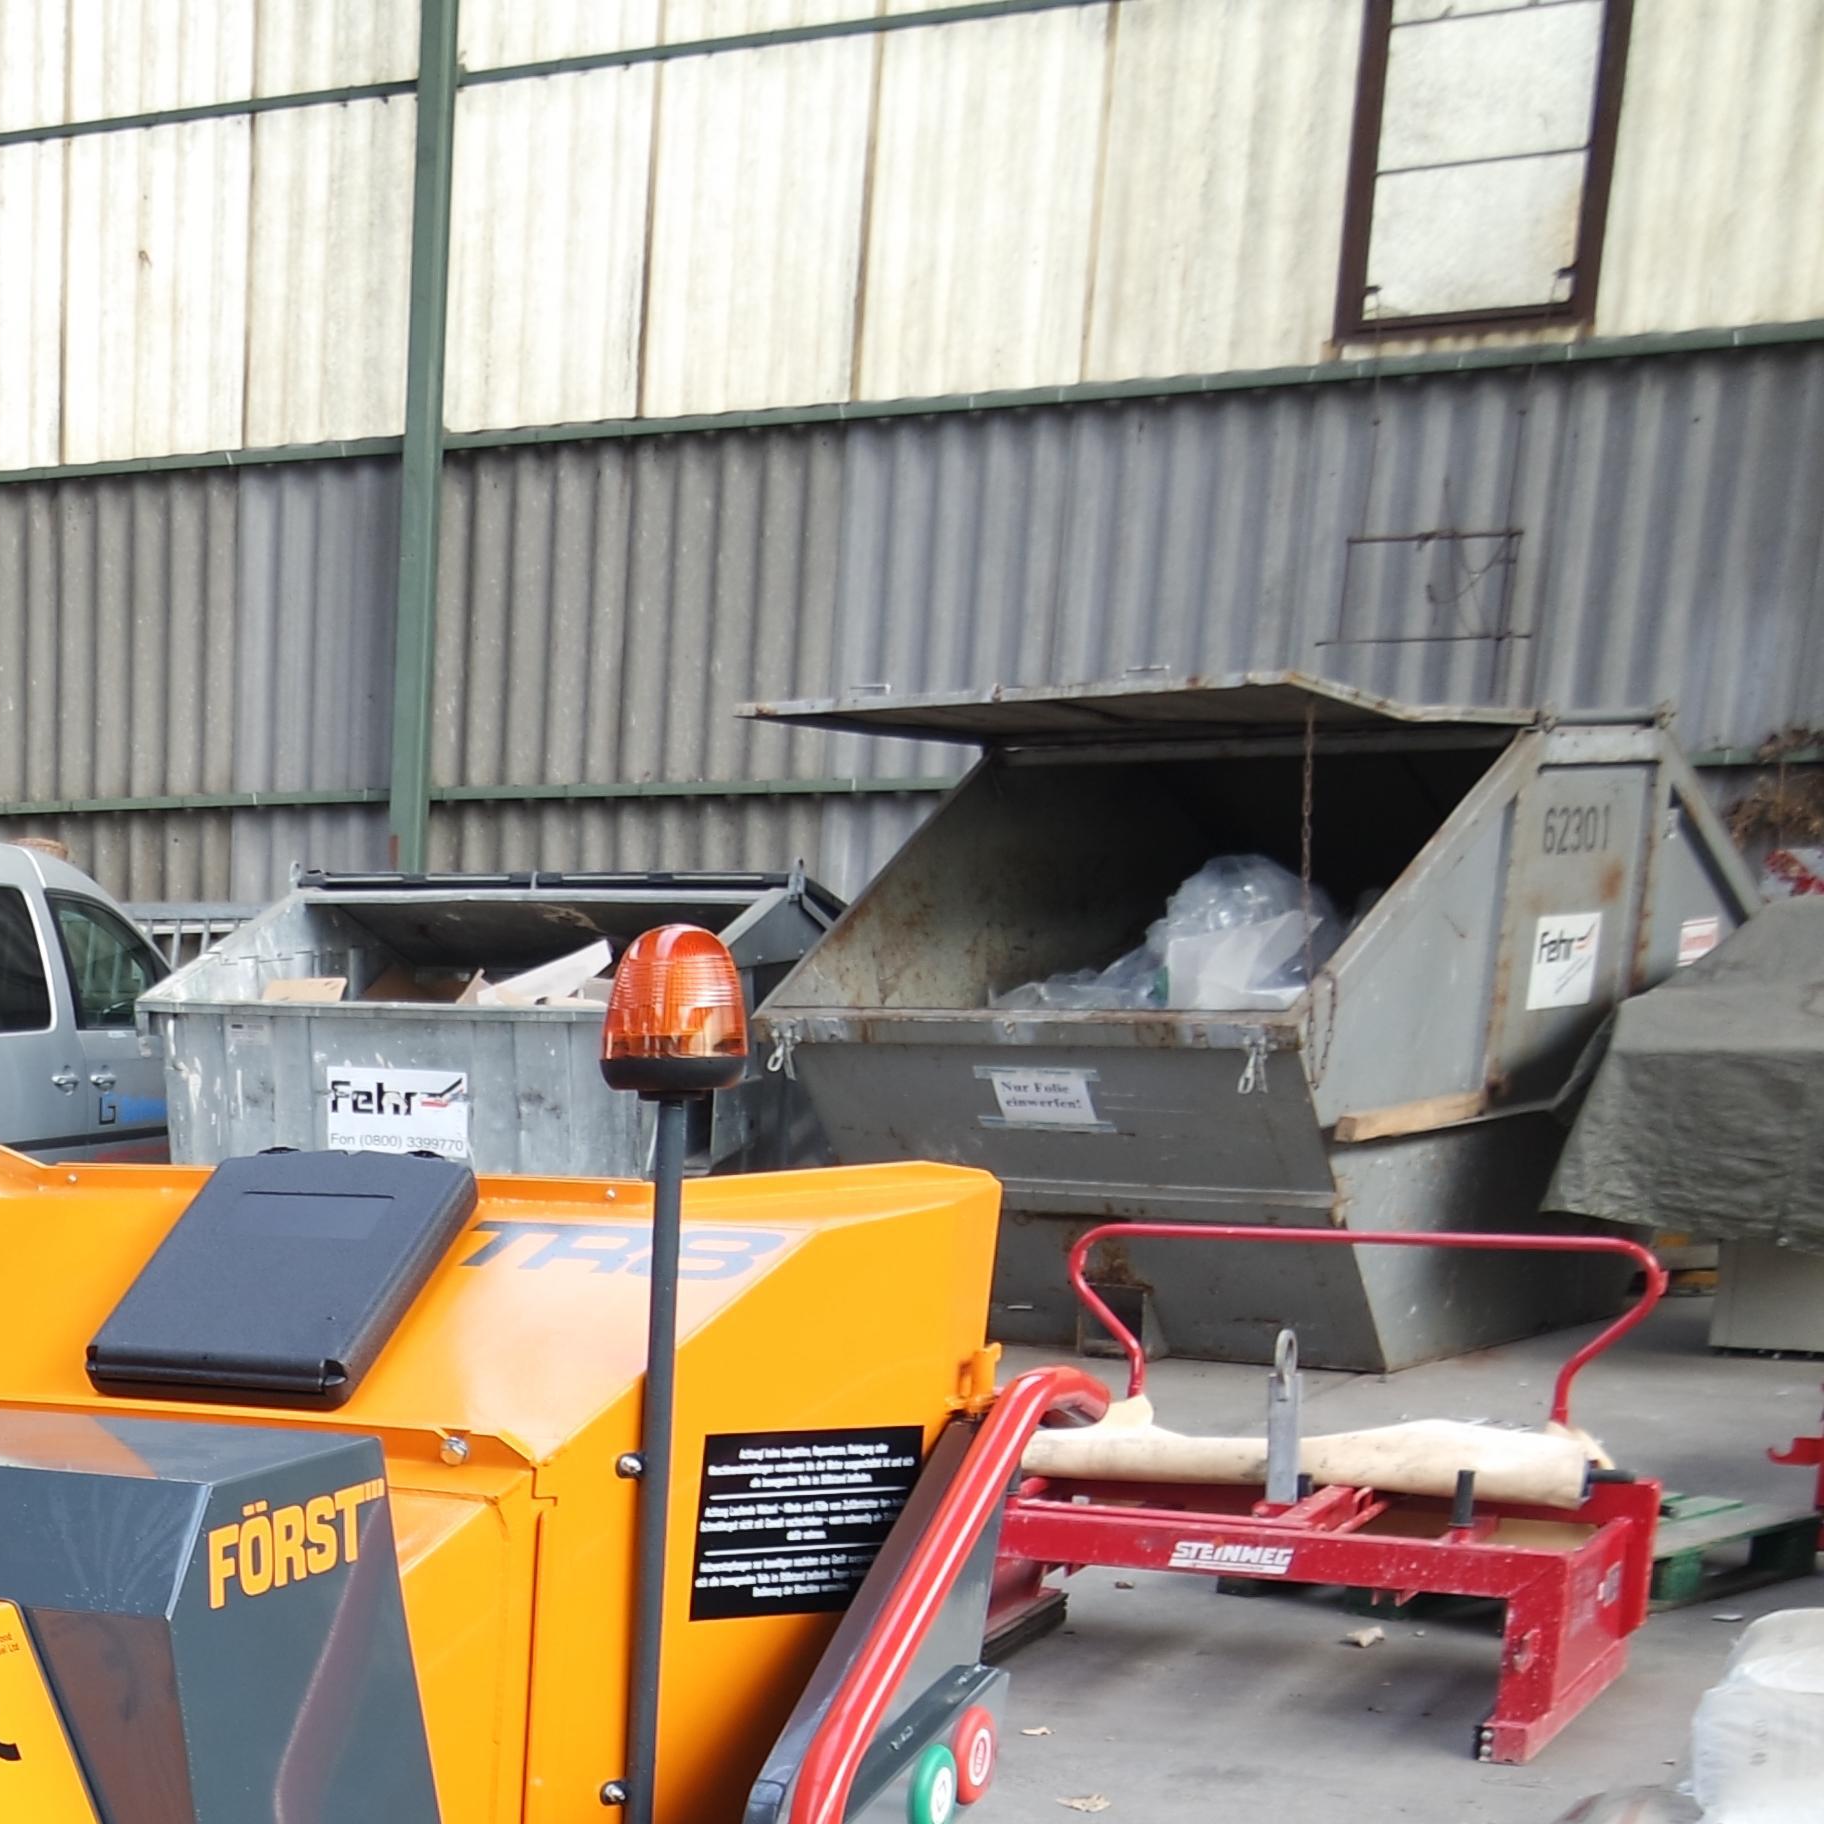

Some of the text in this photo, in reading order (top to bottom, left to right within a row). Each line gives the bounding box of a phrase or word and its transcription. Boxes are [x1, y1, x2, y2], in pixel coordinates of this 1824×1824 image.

[1543, 804, 1611, 855] 62301
[331, 1080, 418, 1116] Fehr
[1001, 1081, 1070, 1094] Nur Folie
[1006, 1097, 1083, 1109] einwerfen!
[331, 1132, 464, 1152] Fon (0800) 3399770
[458, 1220, 786, 1281] TR8
[208, 1485, 366, 1610] FÖRST
